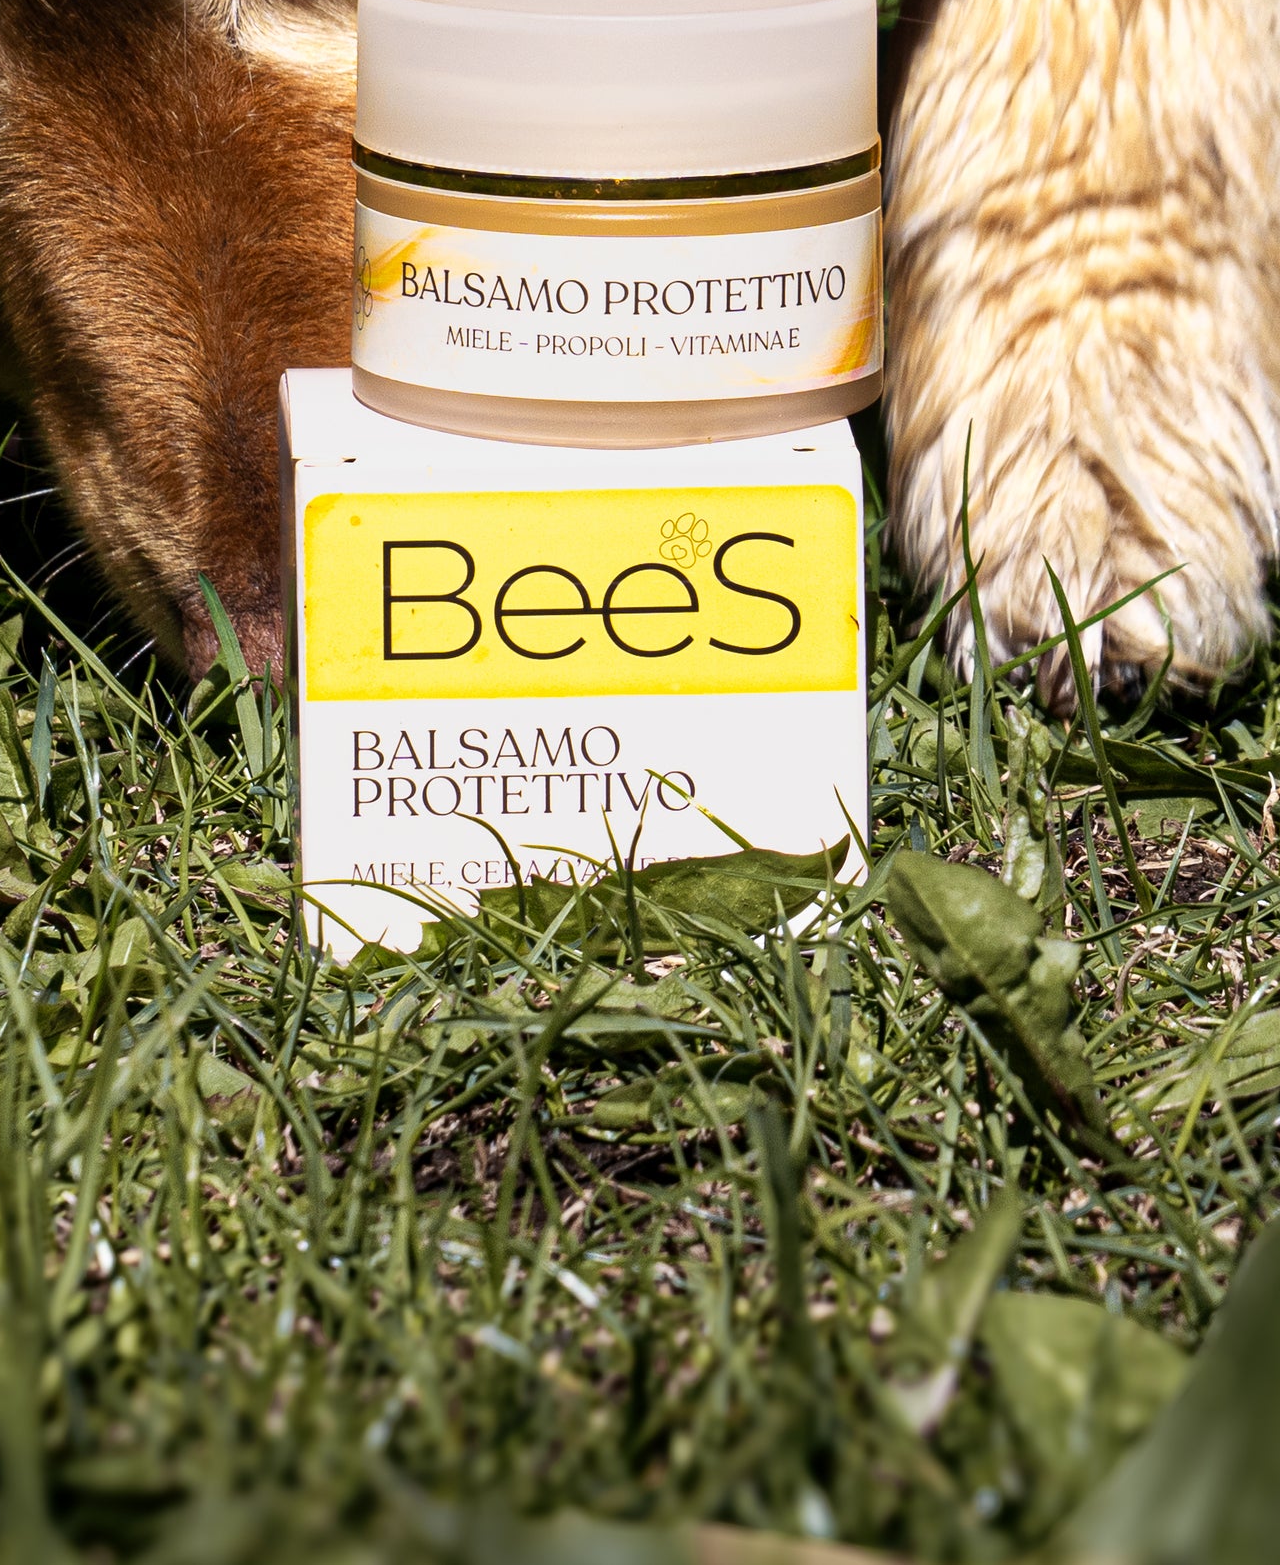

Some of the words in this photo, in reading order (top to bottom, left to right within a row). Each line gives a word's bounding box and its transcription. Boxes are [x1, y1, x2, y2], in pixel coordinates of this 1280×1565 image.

[401, 261, 589, 315] BALSAMO
[604, 264, 846, 315] PROTETTIVO
[446, 325, 513, 352] MIELE
[536, 334, 646, 357] PROPOLI
[382, 532, 801, 661] BeeS
[352, 725, 621, 771] BALSAMO
[352, 770, 696, 817] PROTETTIVO
[351, 862, 453, 888] MIELE,
